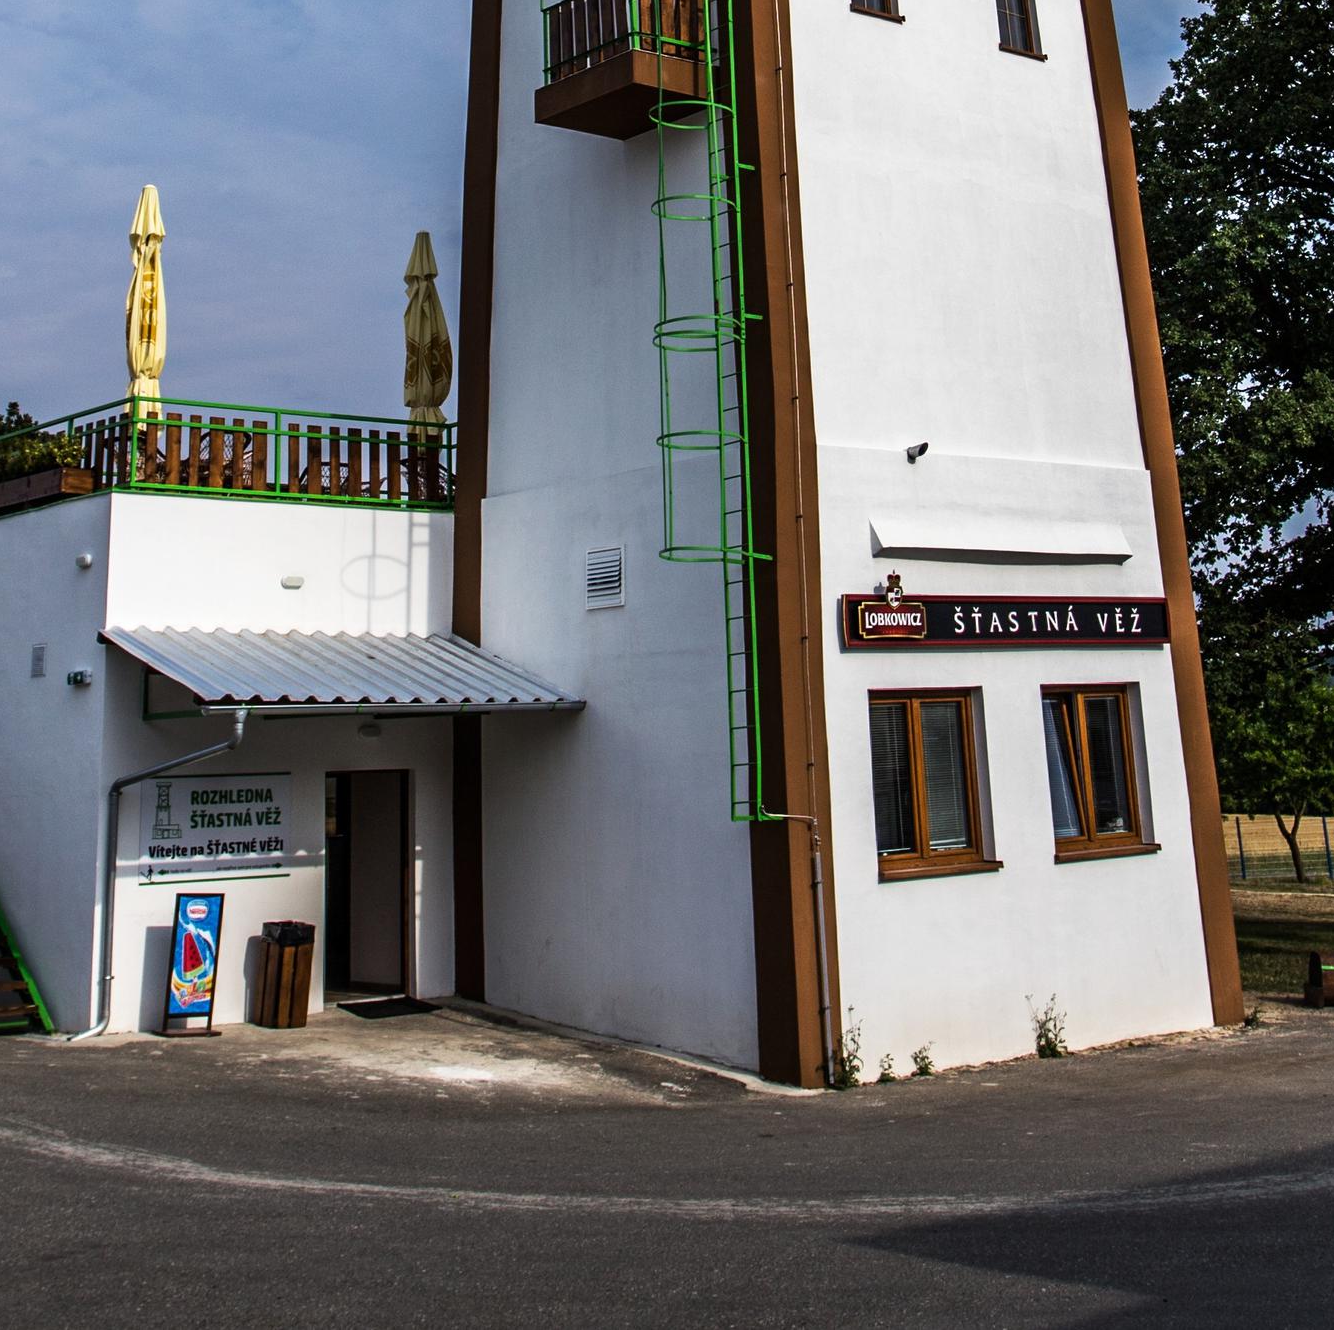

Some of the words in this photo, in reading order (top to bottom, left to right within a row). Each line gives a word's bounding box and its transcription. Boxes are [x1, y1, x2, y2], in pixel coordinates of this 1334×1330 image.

[865, 612, 922, 629] LOBKOWICZ
[954, 605, 1079, 634] ŠŤASTNÁ
[1097, 607, 1142, 633] VĚŽ
[190, 788, 274, 805] ROZHLEDNA
[190, 808, 253, 829] ŠŤASTNÁ
[255, 806, 282, 826] VĚŽ
[148, 844, 188, 859] Vítejte
[190, 845, 205, 856] na
[207, 838, 258, 855] ŠŤASTNÉ
[259, 837, 284, 852] VĚŽI
